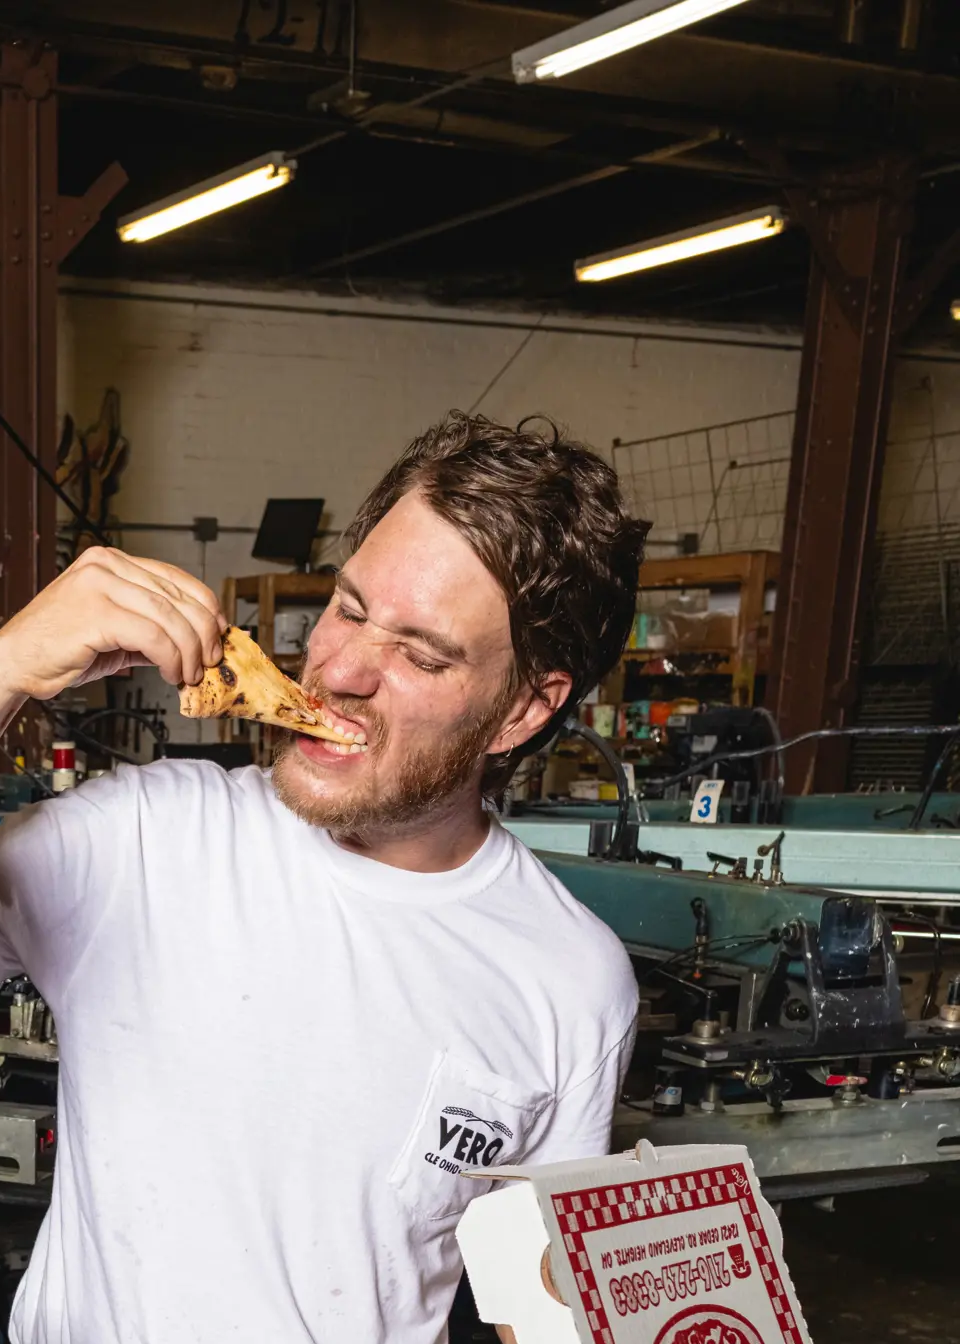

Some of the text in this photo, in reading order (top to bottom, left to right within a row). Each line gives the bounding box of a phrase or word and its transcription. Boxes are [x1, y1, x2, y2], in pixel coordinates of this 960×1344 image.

[697, 795, 711, 818] 3
[439, 1115, 504, 1167] VERO
[424, 1152, 459, 1175] CLE OHIO
[699, 1228, 719, 1247] CEDAR
[721, 1223, 739, 1241] 12421
[649, 1235, 685, 1256] CLEVELAND
[601, 1253, 613, 1269] OH
[609, 1252, 731, 1316] 216-229-8383
